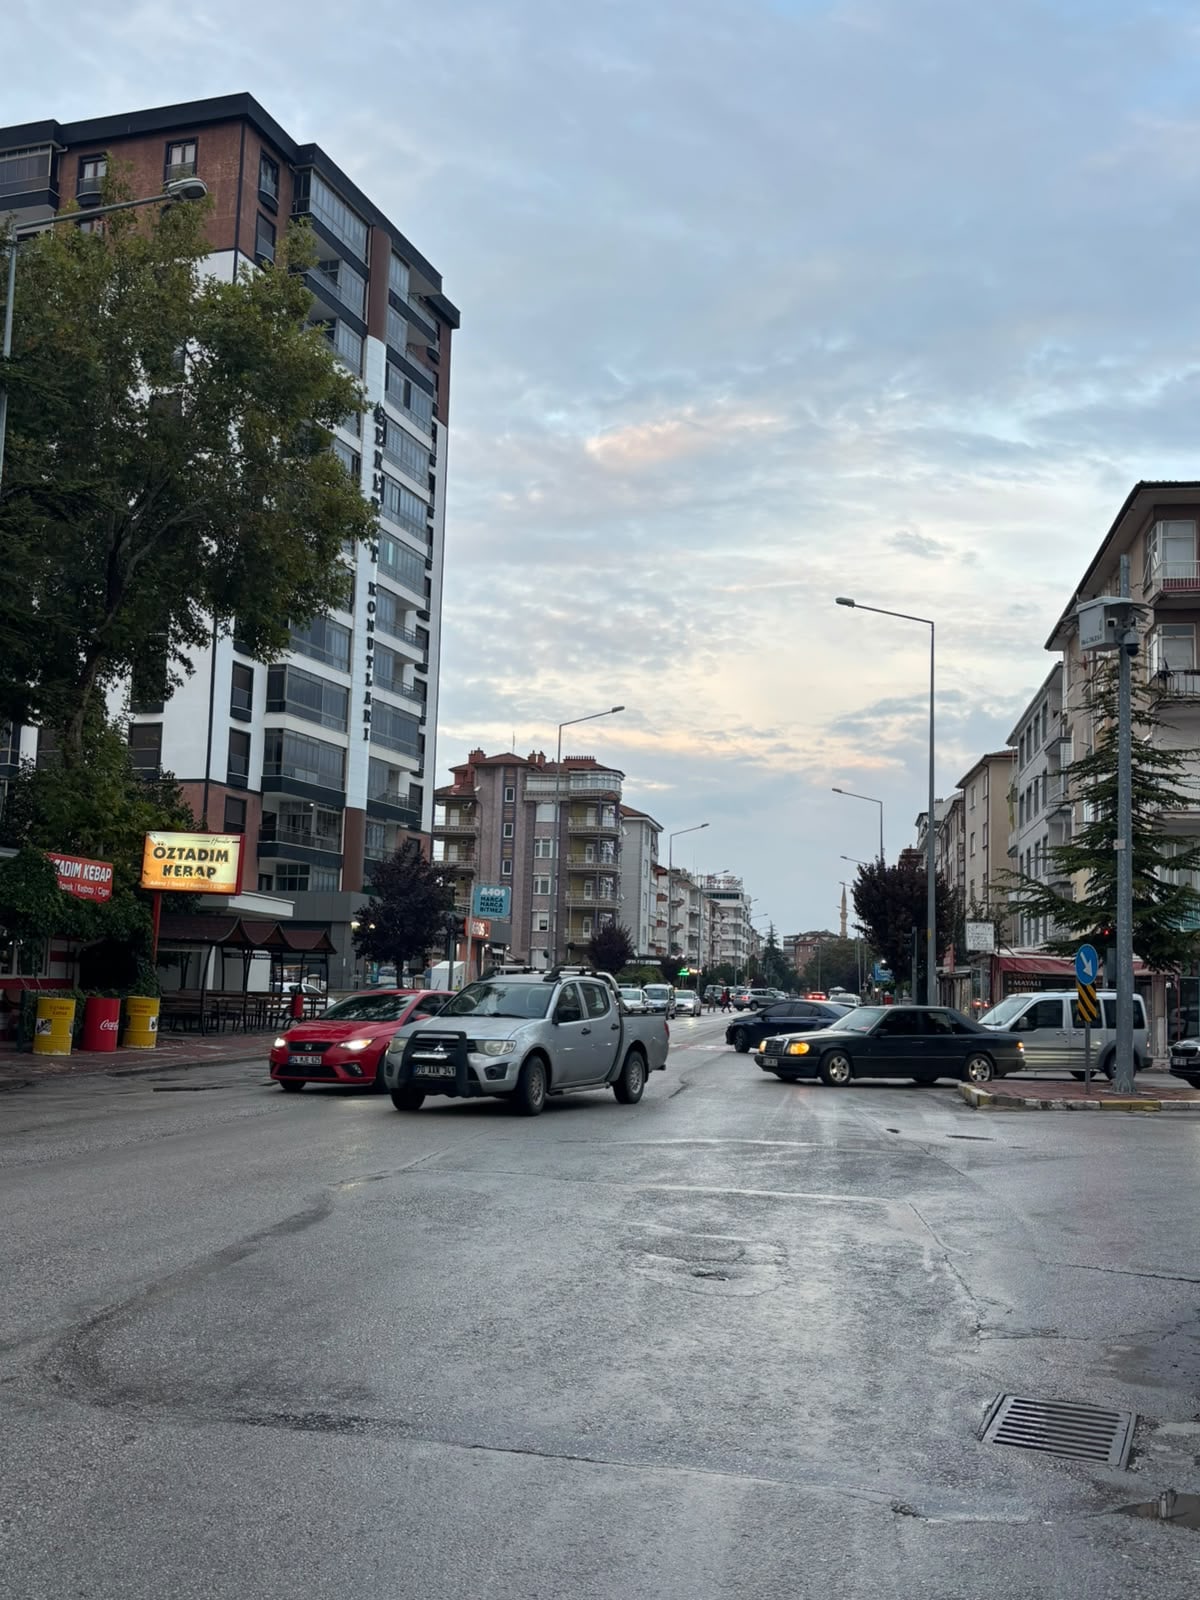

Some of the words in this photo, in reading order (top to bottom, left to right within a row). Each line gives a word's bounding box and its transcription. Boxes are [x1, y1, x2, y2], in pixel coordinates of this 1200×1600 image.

[370, 402, 386, 563] BERET
[363, 581, 376, 741] KONUTLARI
[153, 842, 229, 863] ÖZTADIM
[83, 863, 112, 882] KEBAP
[163, 865, 217, 879] KEBAP
